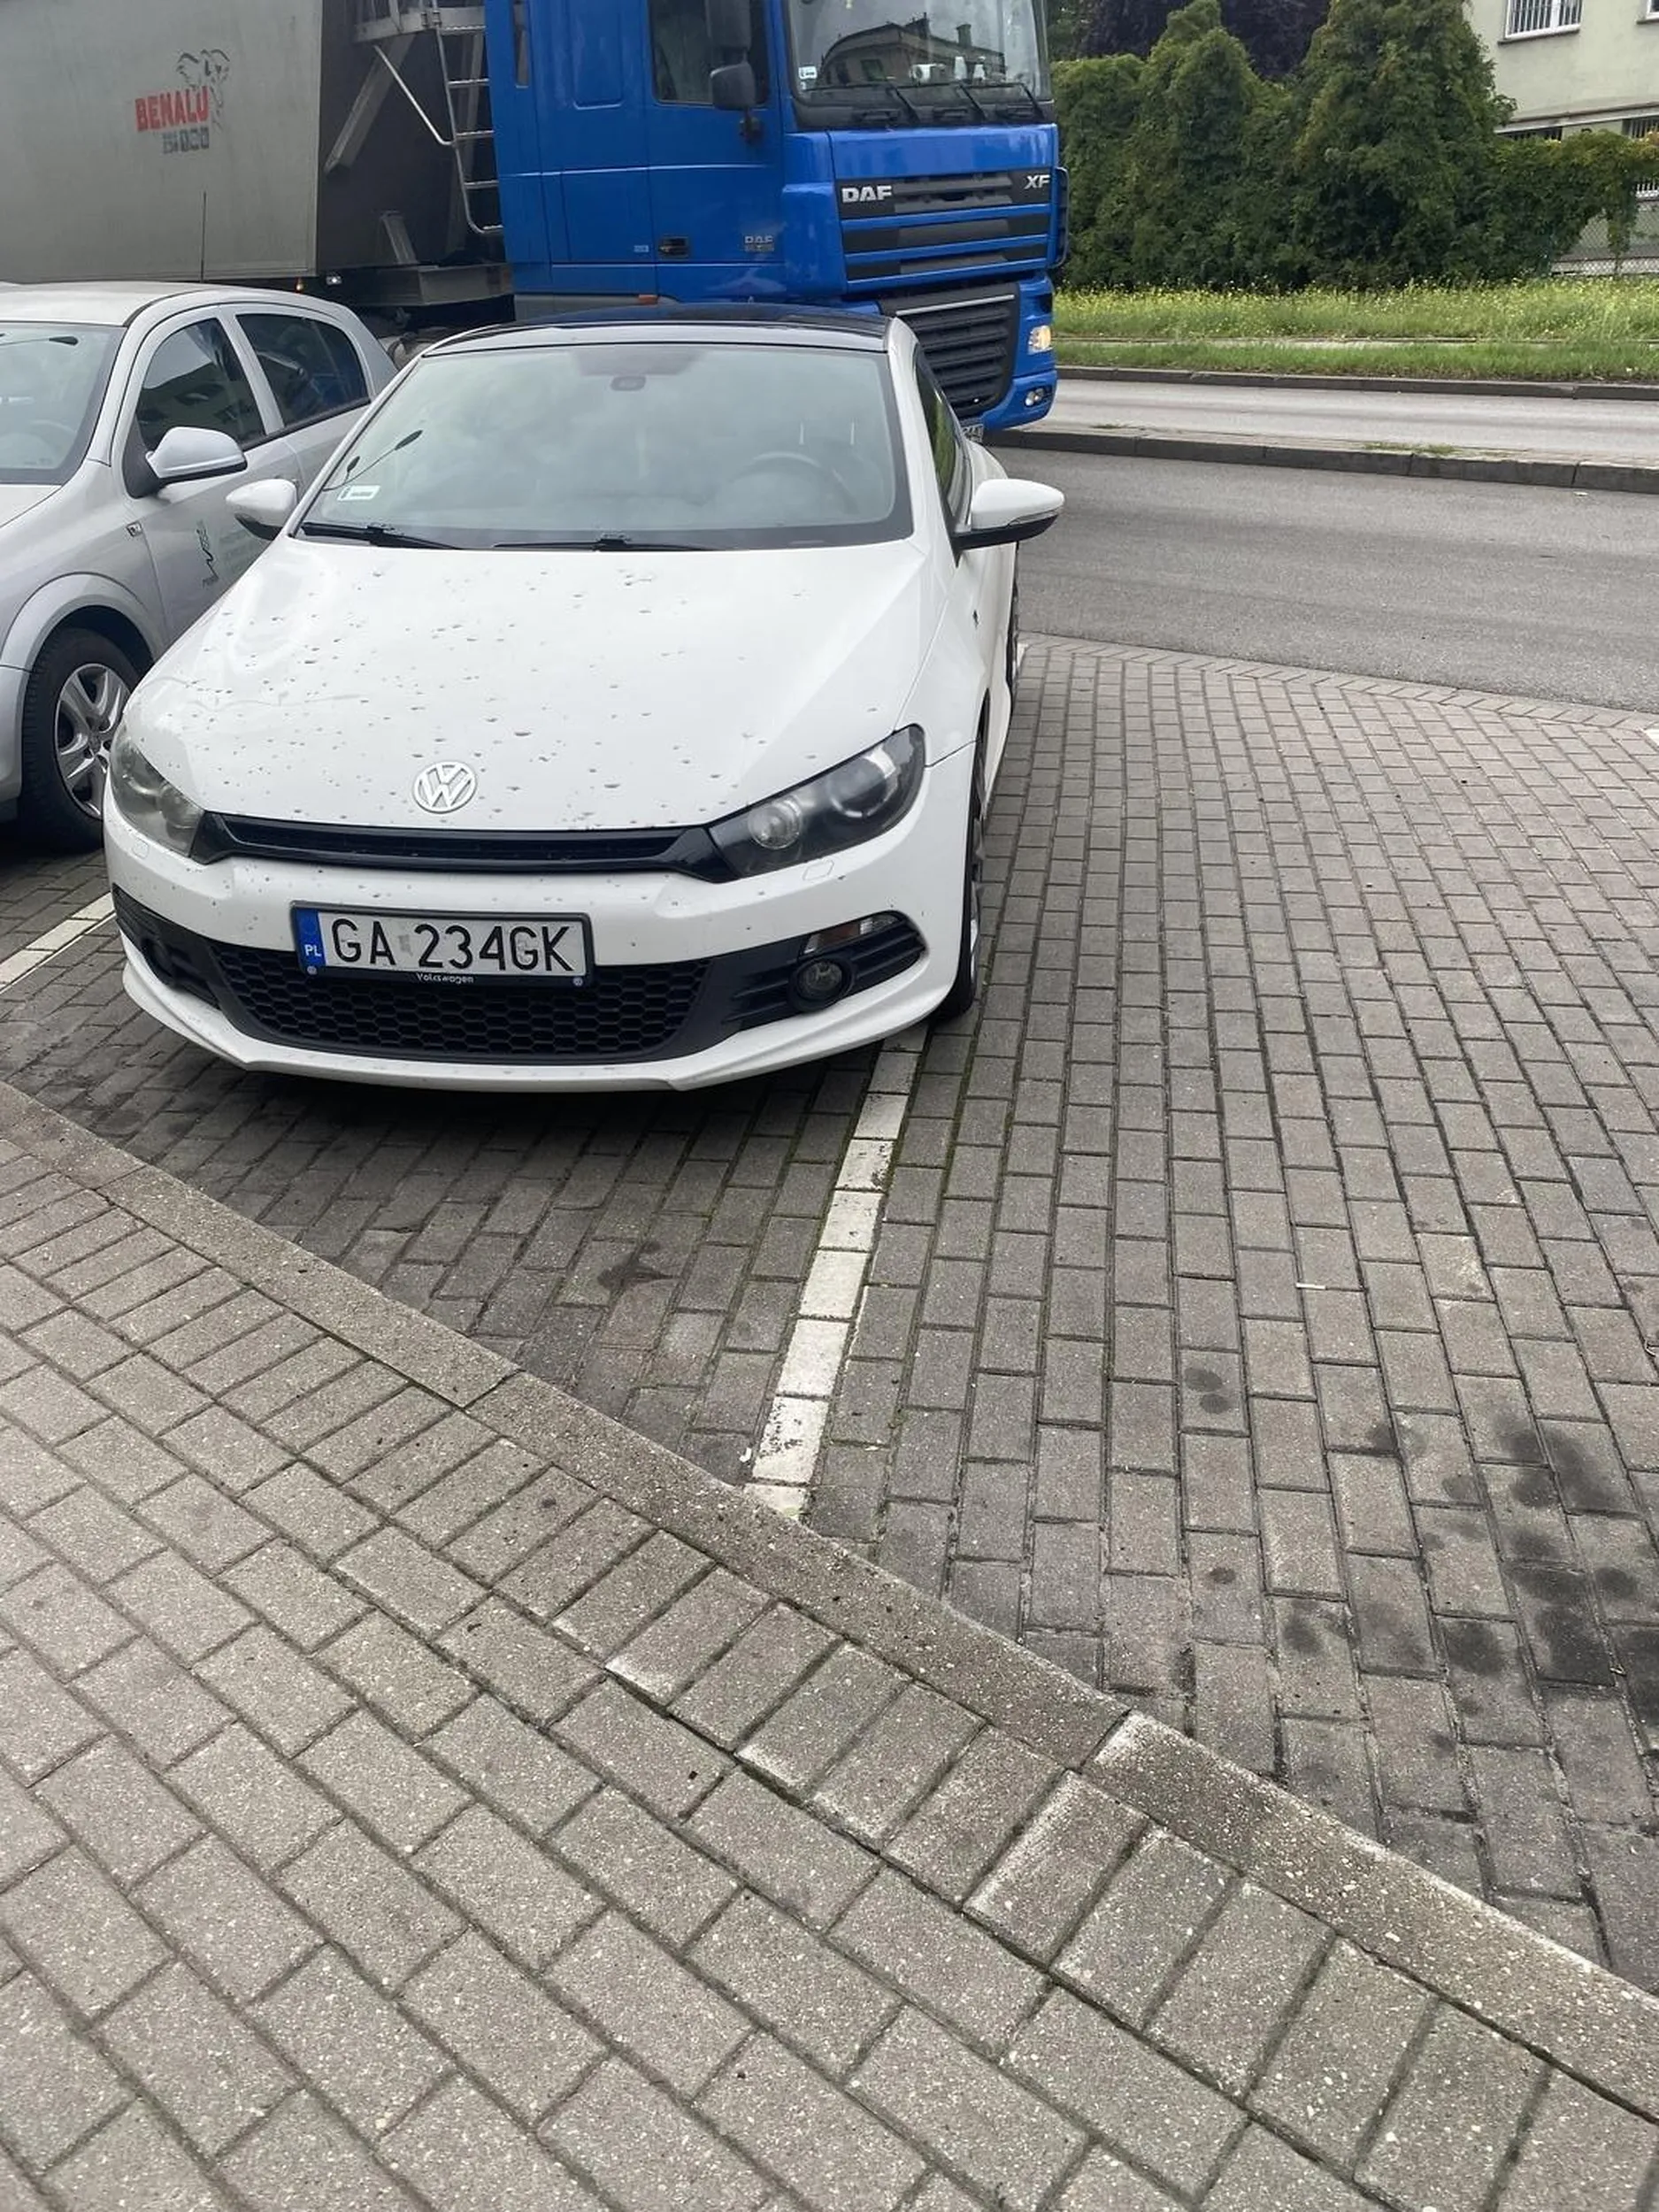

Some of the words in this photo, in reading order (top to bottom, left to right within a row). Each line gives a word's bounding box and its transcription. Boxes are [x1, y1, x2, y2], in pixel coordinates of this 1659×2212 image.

[135, 86, 209, 132] BENALU
[1025, 174, 1050, 190] XF
[841, 185, 893, 204] DAF
[304, 944, 322, 956] PL
[331, 918, 397, 965] GA
[414, 923, 574, 972] 234GK
[416, 973, 474, 986] Volkswagen
